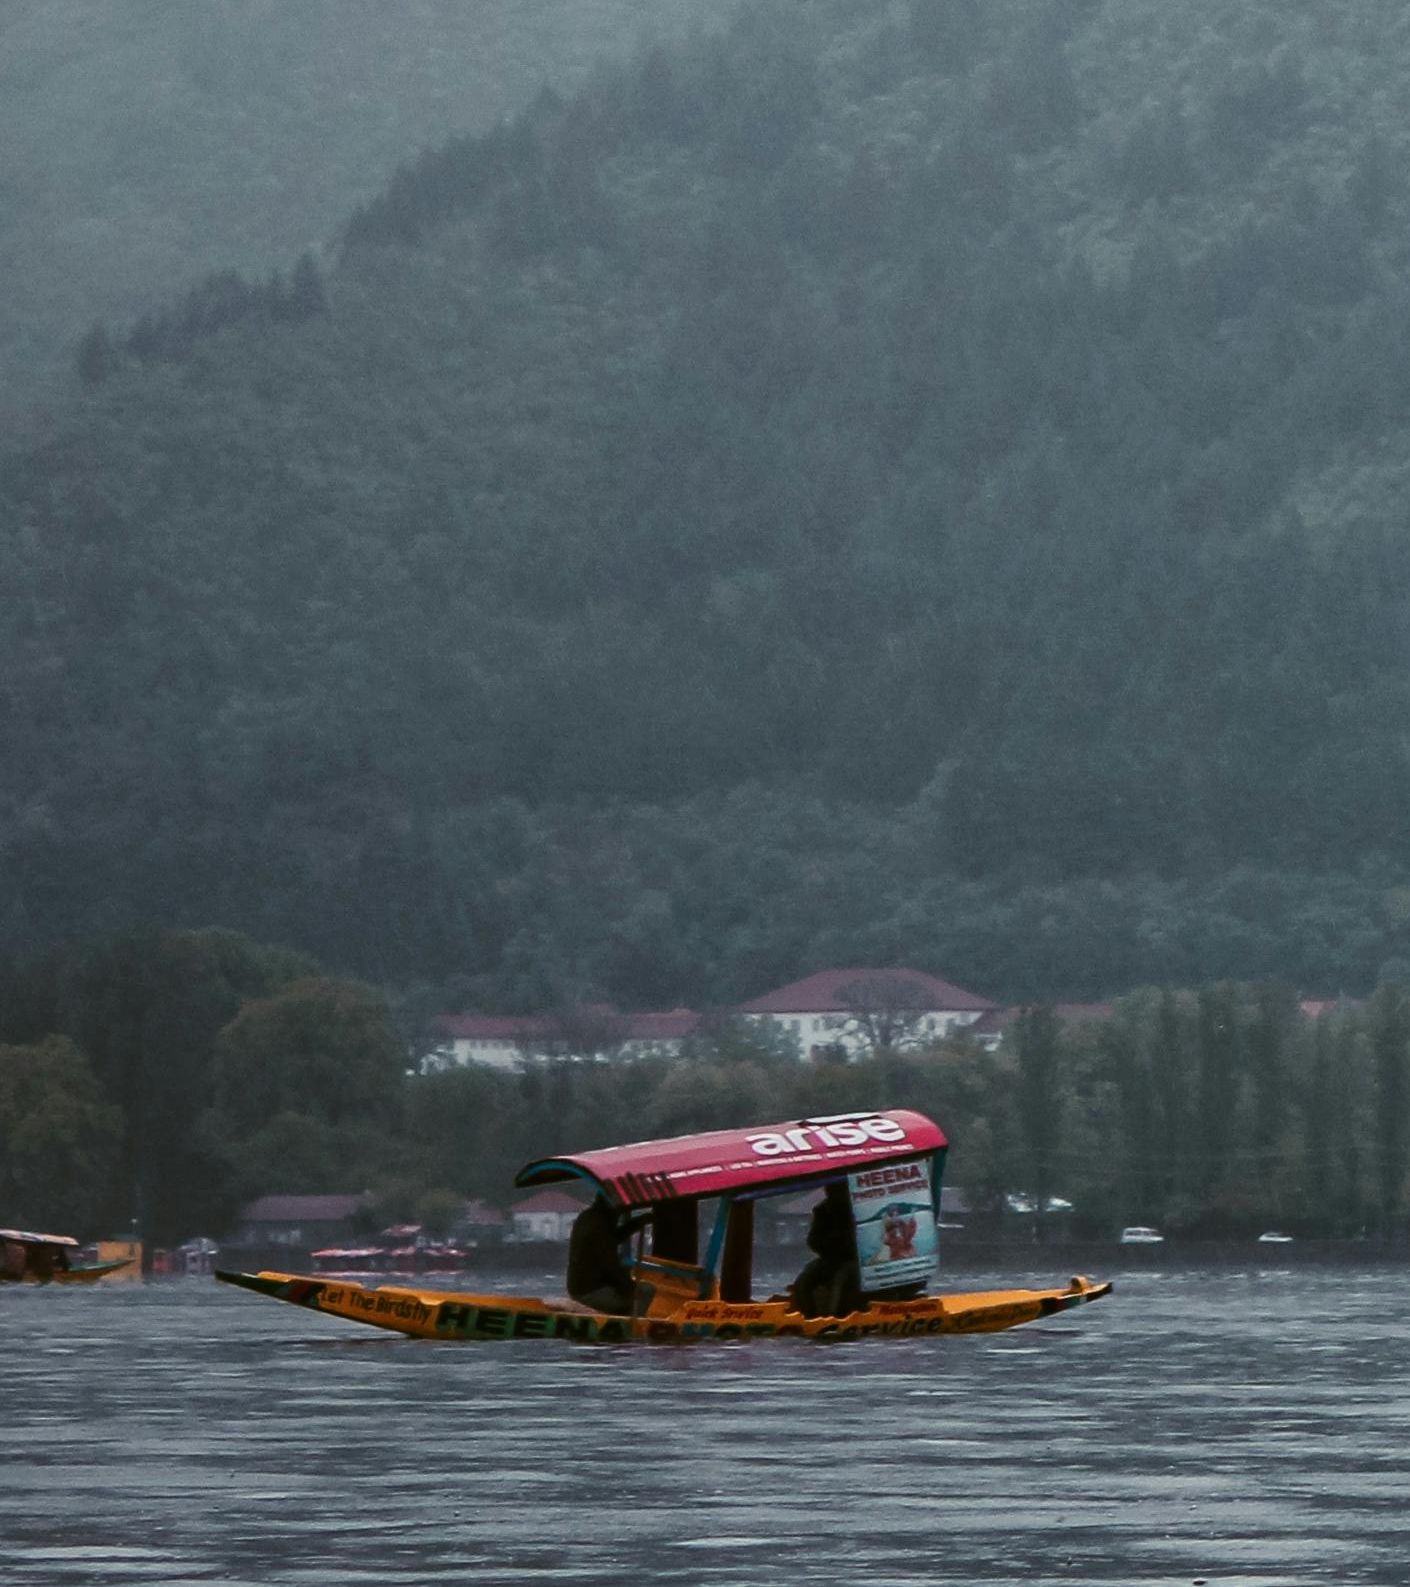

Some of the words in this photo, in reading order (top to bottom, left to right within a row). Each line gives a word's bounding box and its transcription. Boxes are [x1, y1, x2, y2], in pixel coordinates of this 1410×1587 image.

[745, 1118, 906, 1156] arise
[857, 1164, 921, 1187] HEENA
[320, 1289, 344, 1304] Let
[349, 1291, 374, 1309] The
[436, 1301, 626, 1341] HEENA
